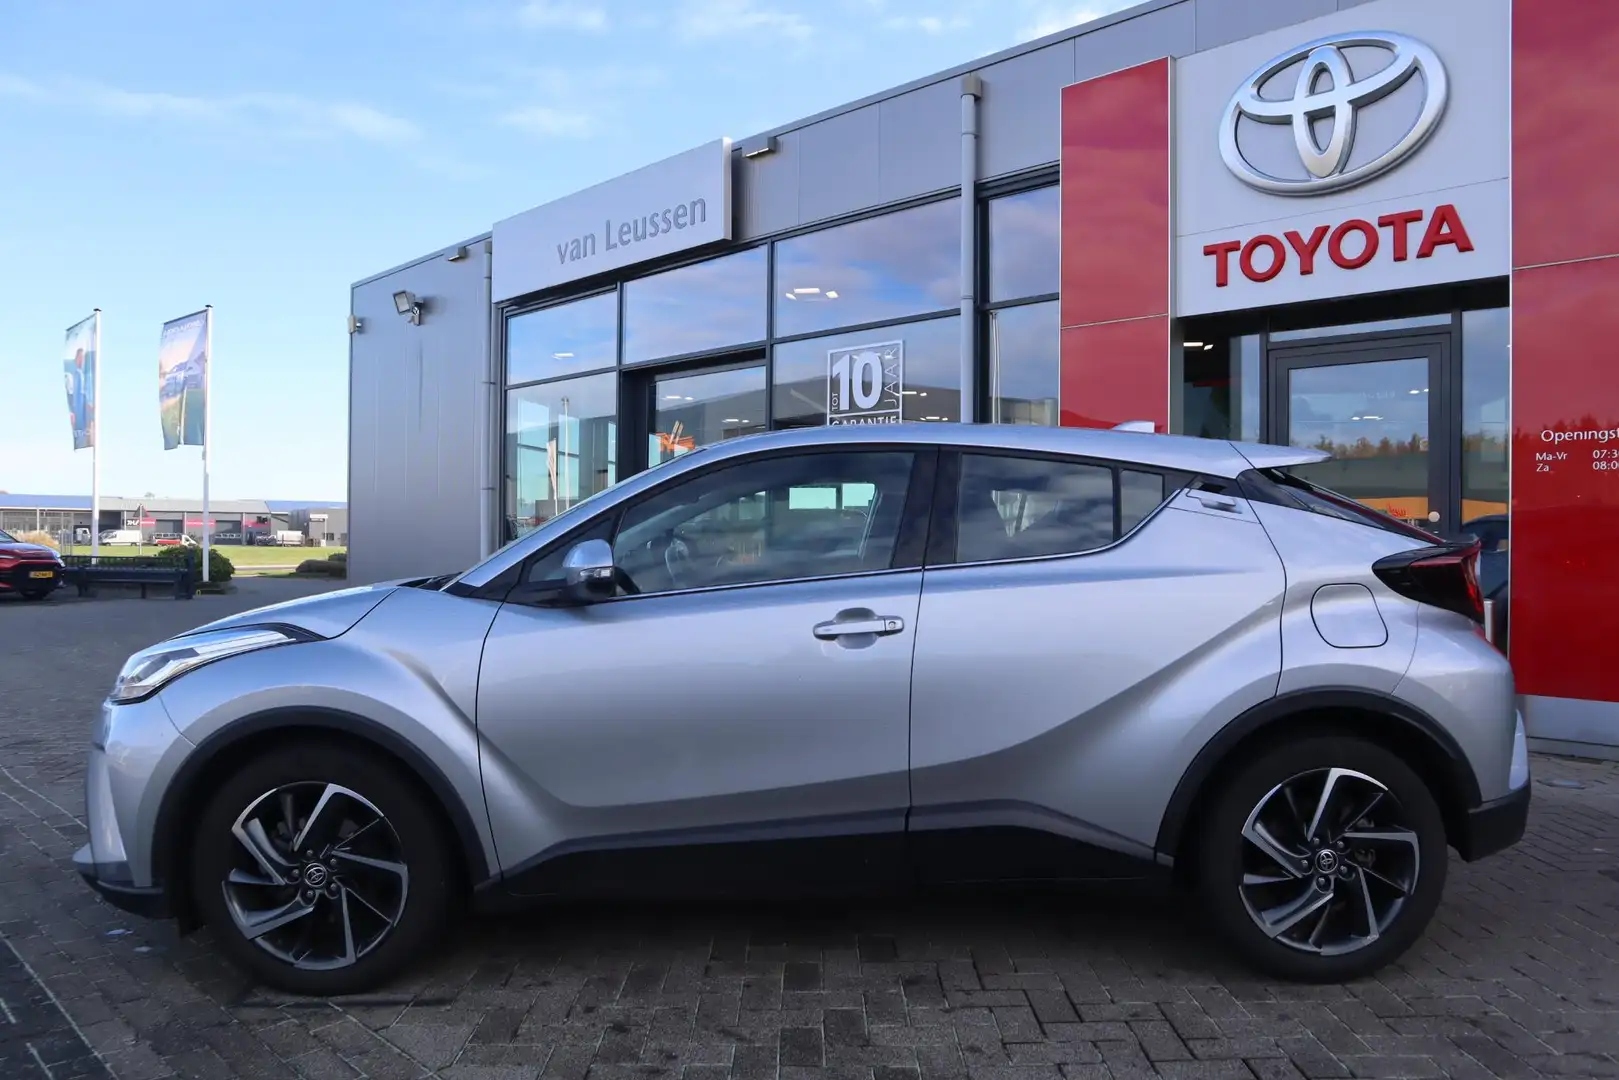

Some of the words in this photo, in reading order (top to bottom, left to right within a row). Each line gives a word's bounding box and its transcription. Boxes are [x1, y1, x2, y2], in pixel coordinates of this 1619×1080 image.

[557, 233, 596, 264] van
[605, 197, 706, 251] Leussen
[1203, 204, 1474, 287] TOYOTA
[832, 351, 882, 410] 10
[1536, 452, 1567, 461] Ma-Vr
[1592, 449, 1619, 459] 07:3
[1536, 463, 1550, 472] Za
[1592, 460, 1619, 470] 08:0
